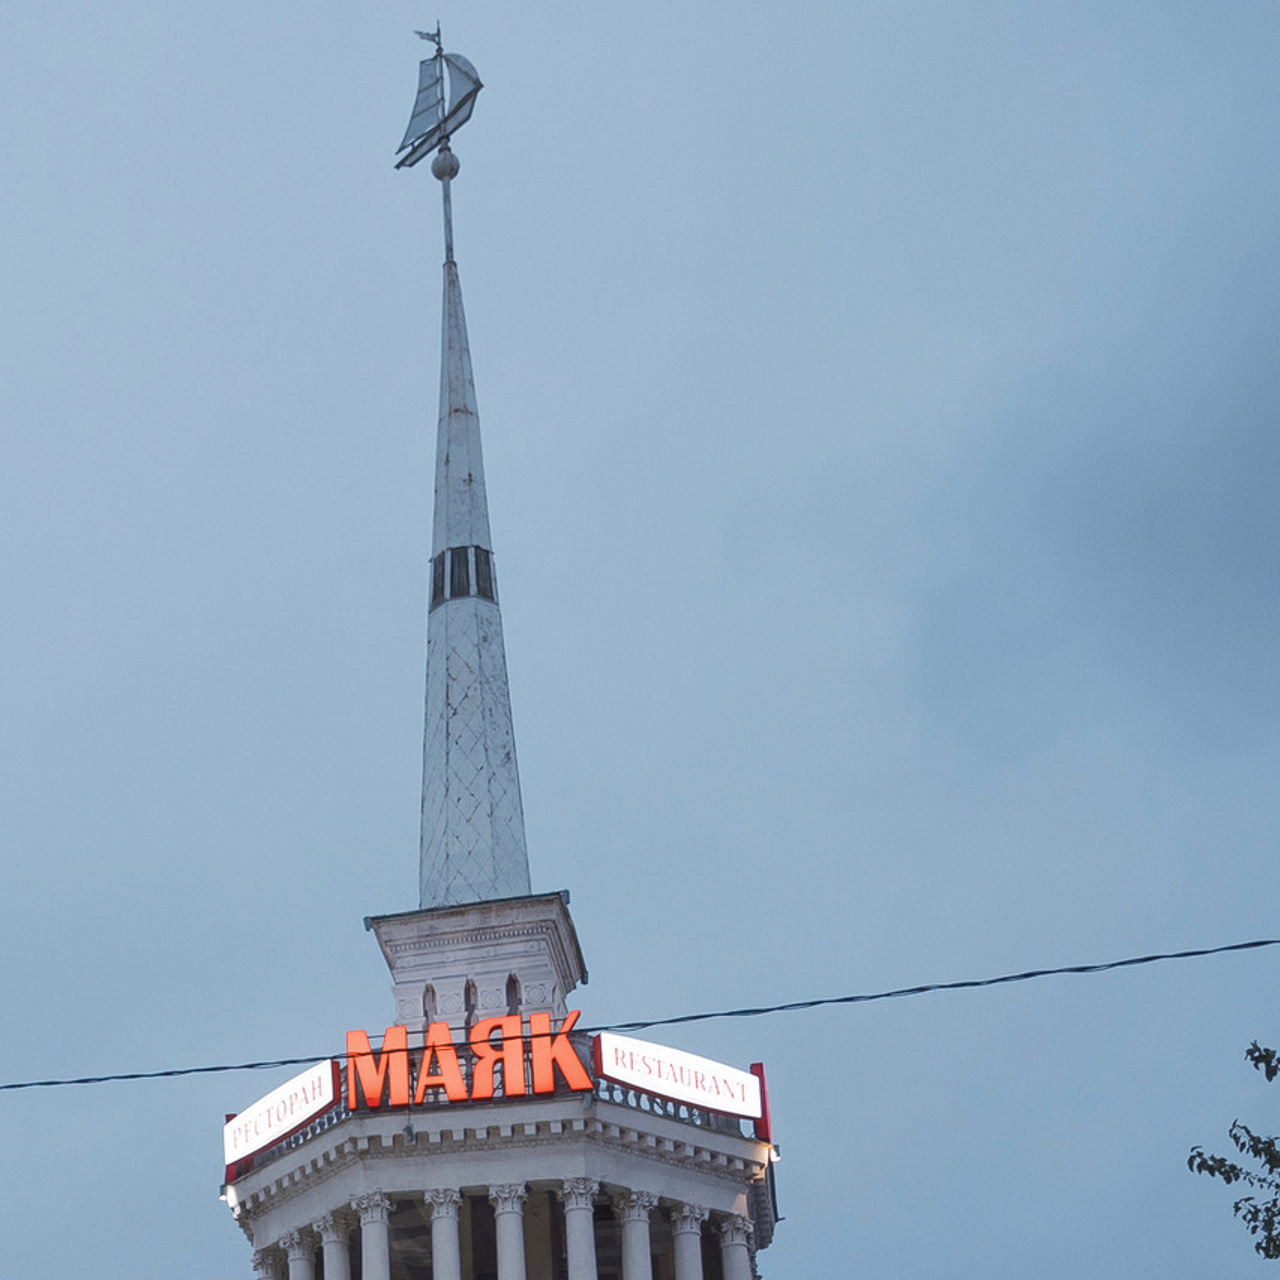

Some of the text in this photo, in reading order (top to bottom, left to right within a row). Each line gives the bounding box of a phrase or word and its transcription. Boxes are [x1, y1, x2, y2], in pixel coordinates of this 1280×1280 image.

[346, 1009, 594, 1110] МАЯК
[613, 1046, 750, 1103] RESTAURANT
[232, 1075, 324, 1150] РЕСТОРАН
